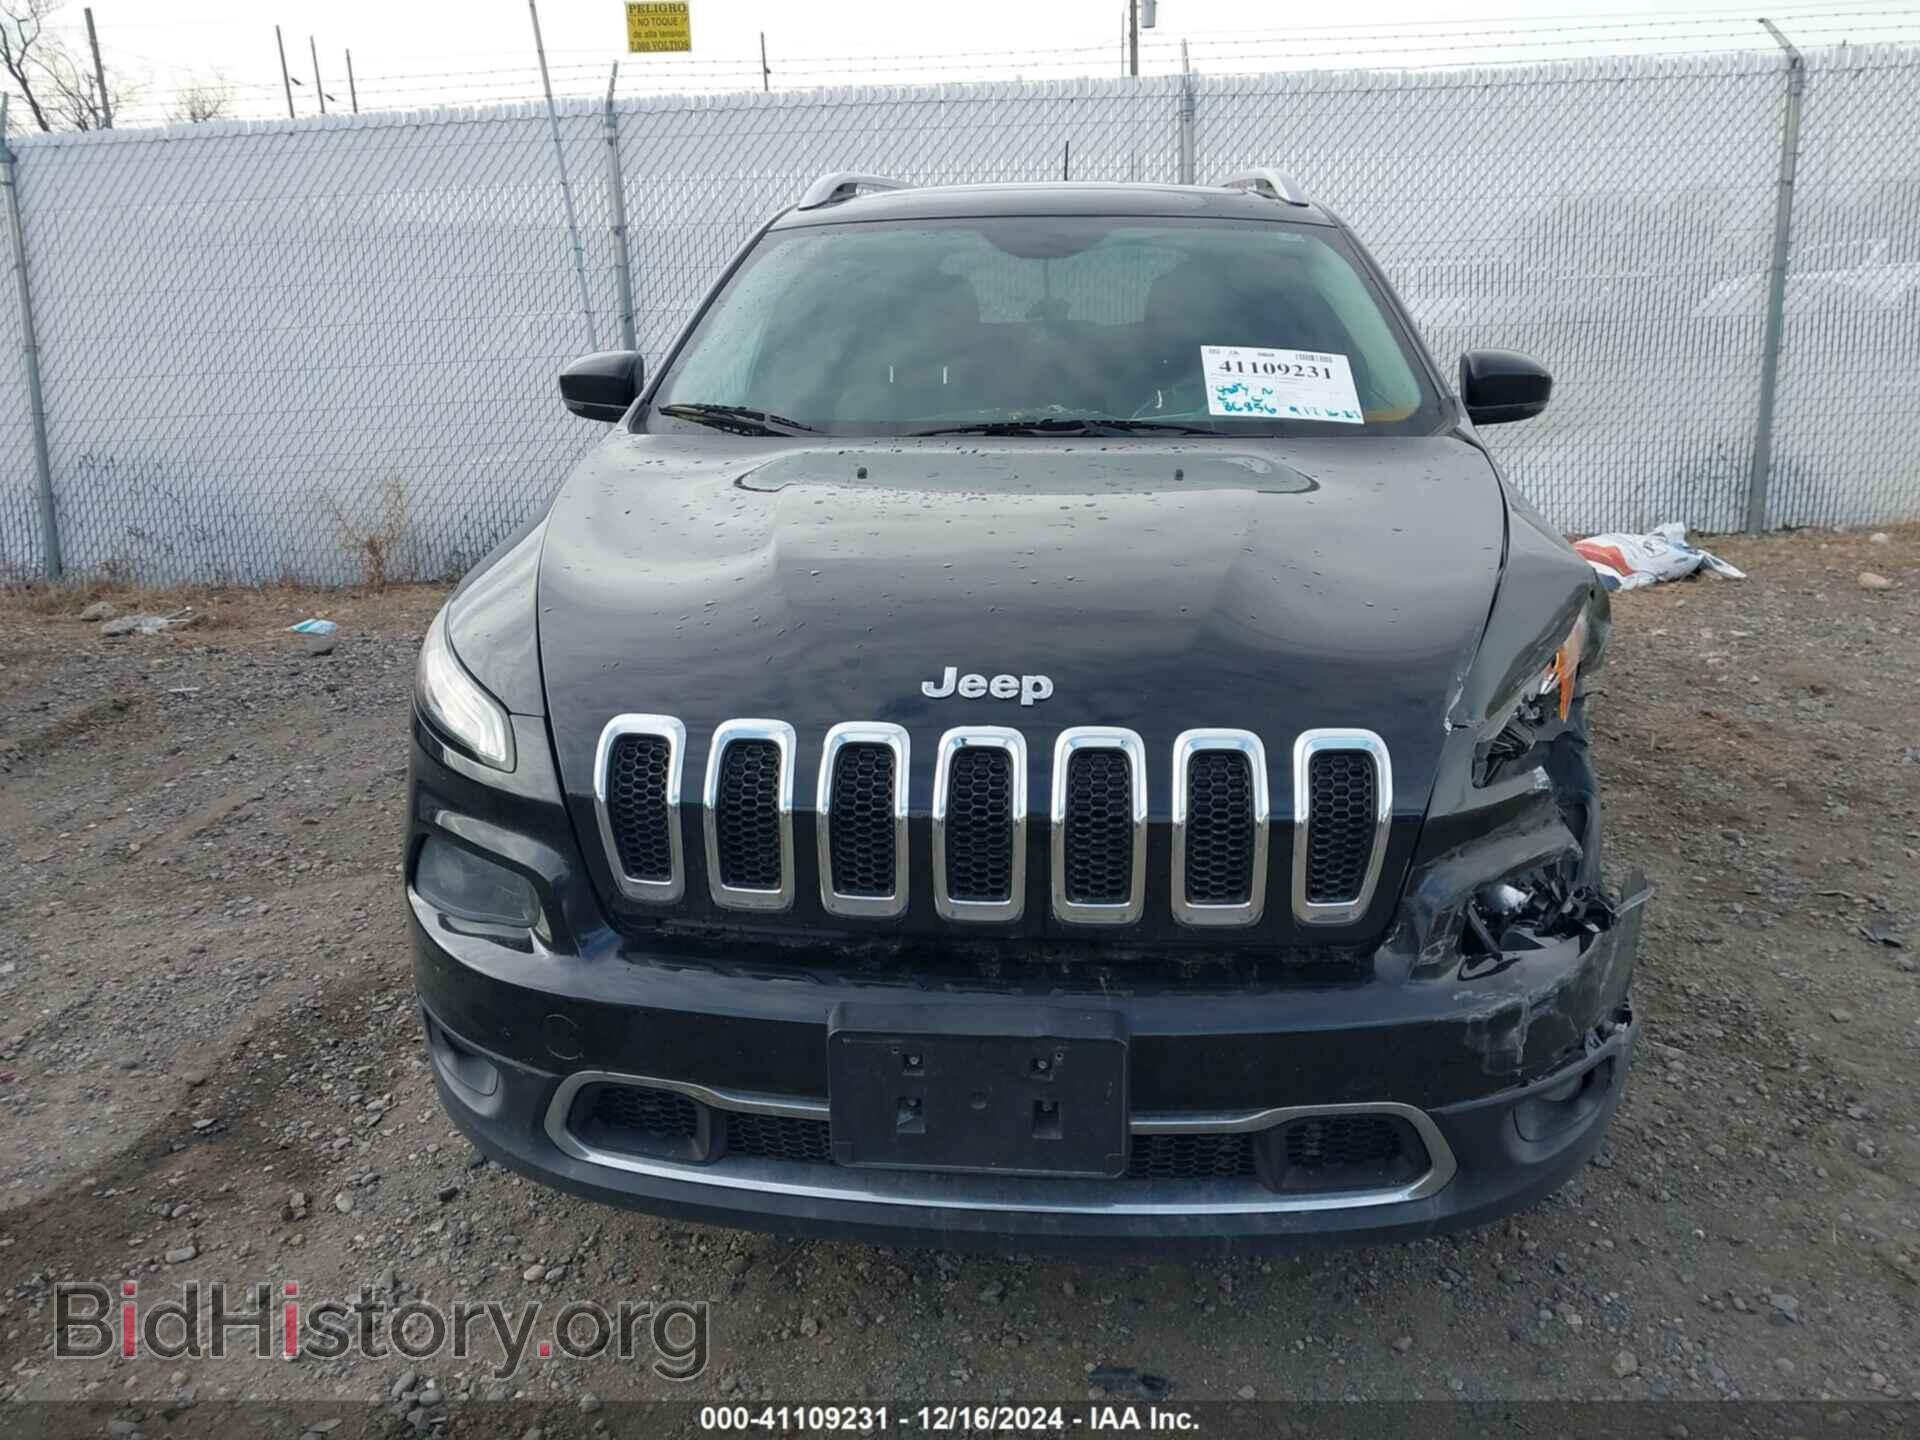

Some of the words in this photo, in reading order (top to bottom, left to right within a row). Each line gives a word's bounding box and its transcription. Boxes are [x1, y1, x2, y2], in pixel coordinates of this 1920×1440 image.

[628, 3, 687, 14] PELIGRO
[638, 18, 650, 27] NO
[651, 17, 678, 27] TOQUE
[652, 40, 688, 51] VOLTIOS
[1219, 360, 1332, 379] 41109231
[921, 666, 1054, 705] Jeep
